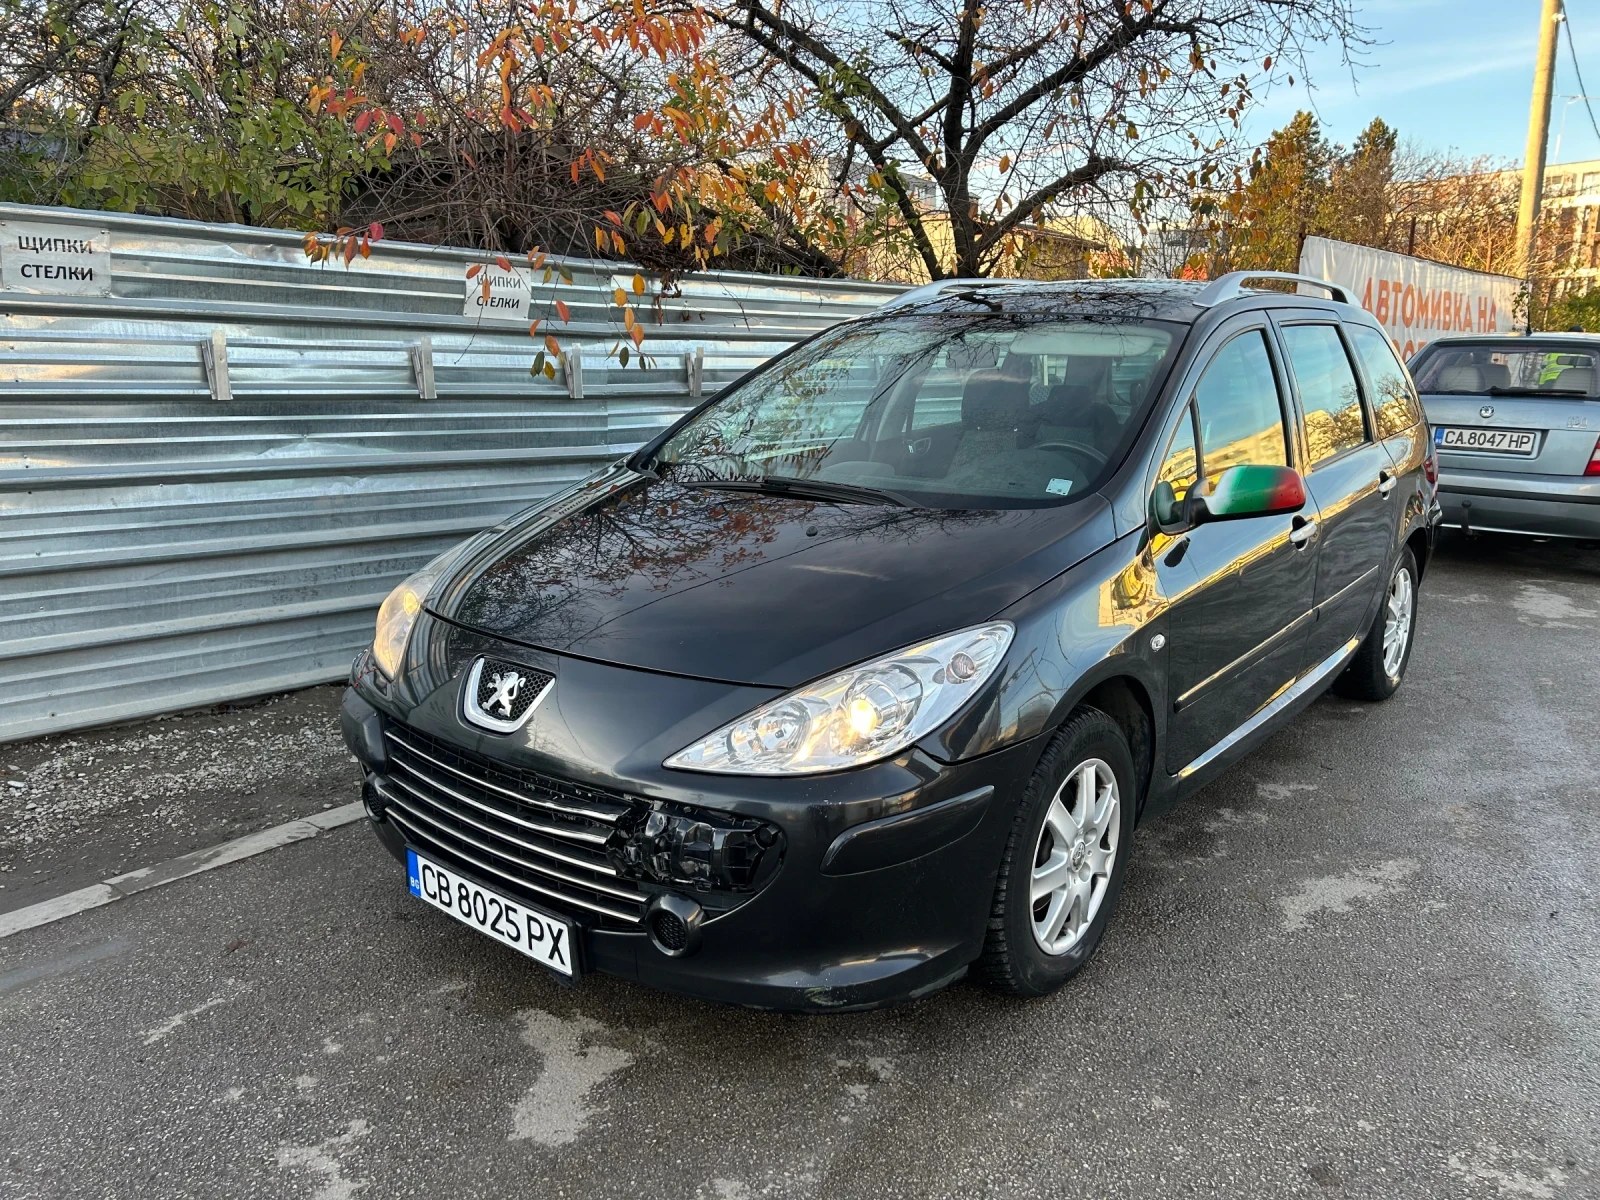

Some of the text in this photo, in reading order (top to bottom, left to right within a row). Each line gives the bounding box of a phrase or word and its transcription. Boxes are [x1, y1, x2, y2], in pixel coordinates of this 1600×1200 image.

[18, 236, 93, 254] ЩИПКИ
[20, 264, 93, 281] СТЕЛКИ
[1362, 277, 1497, 333] АВТОМИВКА НА
[1467, 432, 1507, 447] 8047
[1508, 434, 1531, 449] HP
[409, 875, 420, 890] BG
[422, 864, 566, 966] CB 8025 PX
